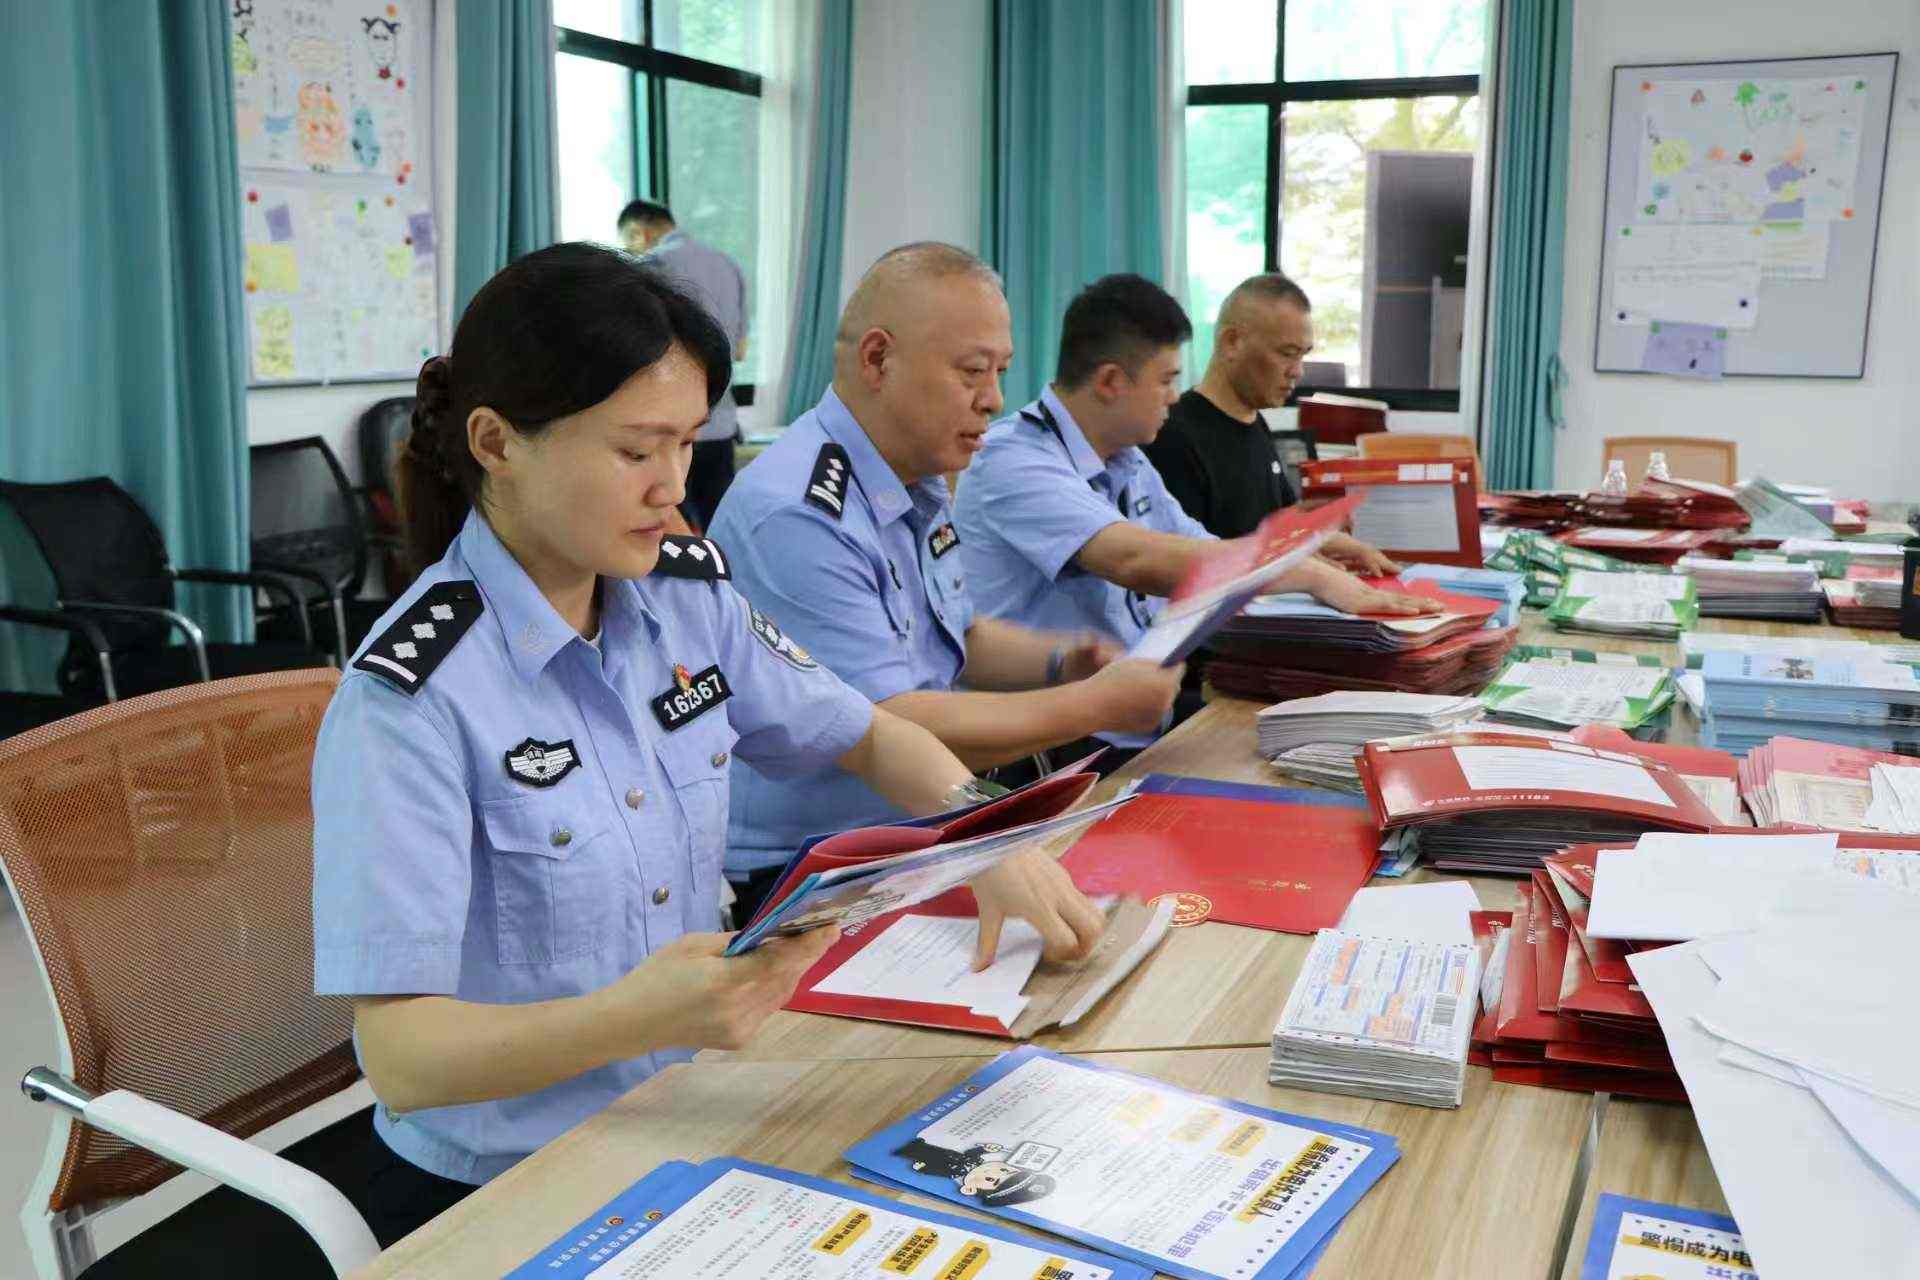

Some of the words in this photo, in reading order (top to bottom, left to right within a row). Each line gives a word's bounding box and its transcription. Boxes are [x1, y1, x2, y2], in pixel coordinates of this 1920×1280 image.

[1249, 1141, 1340, 1218] 警惕成为电诈工具人
